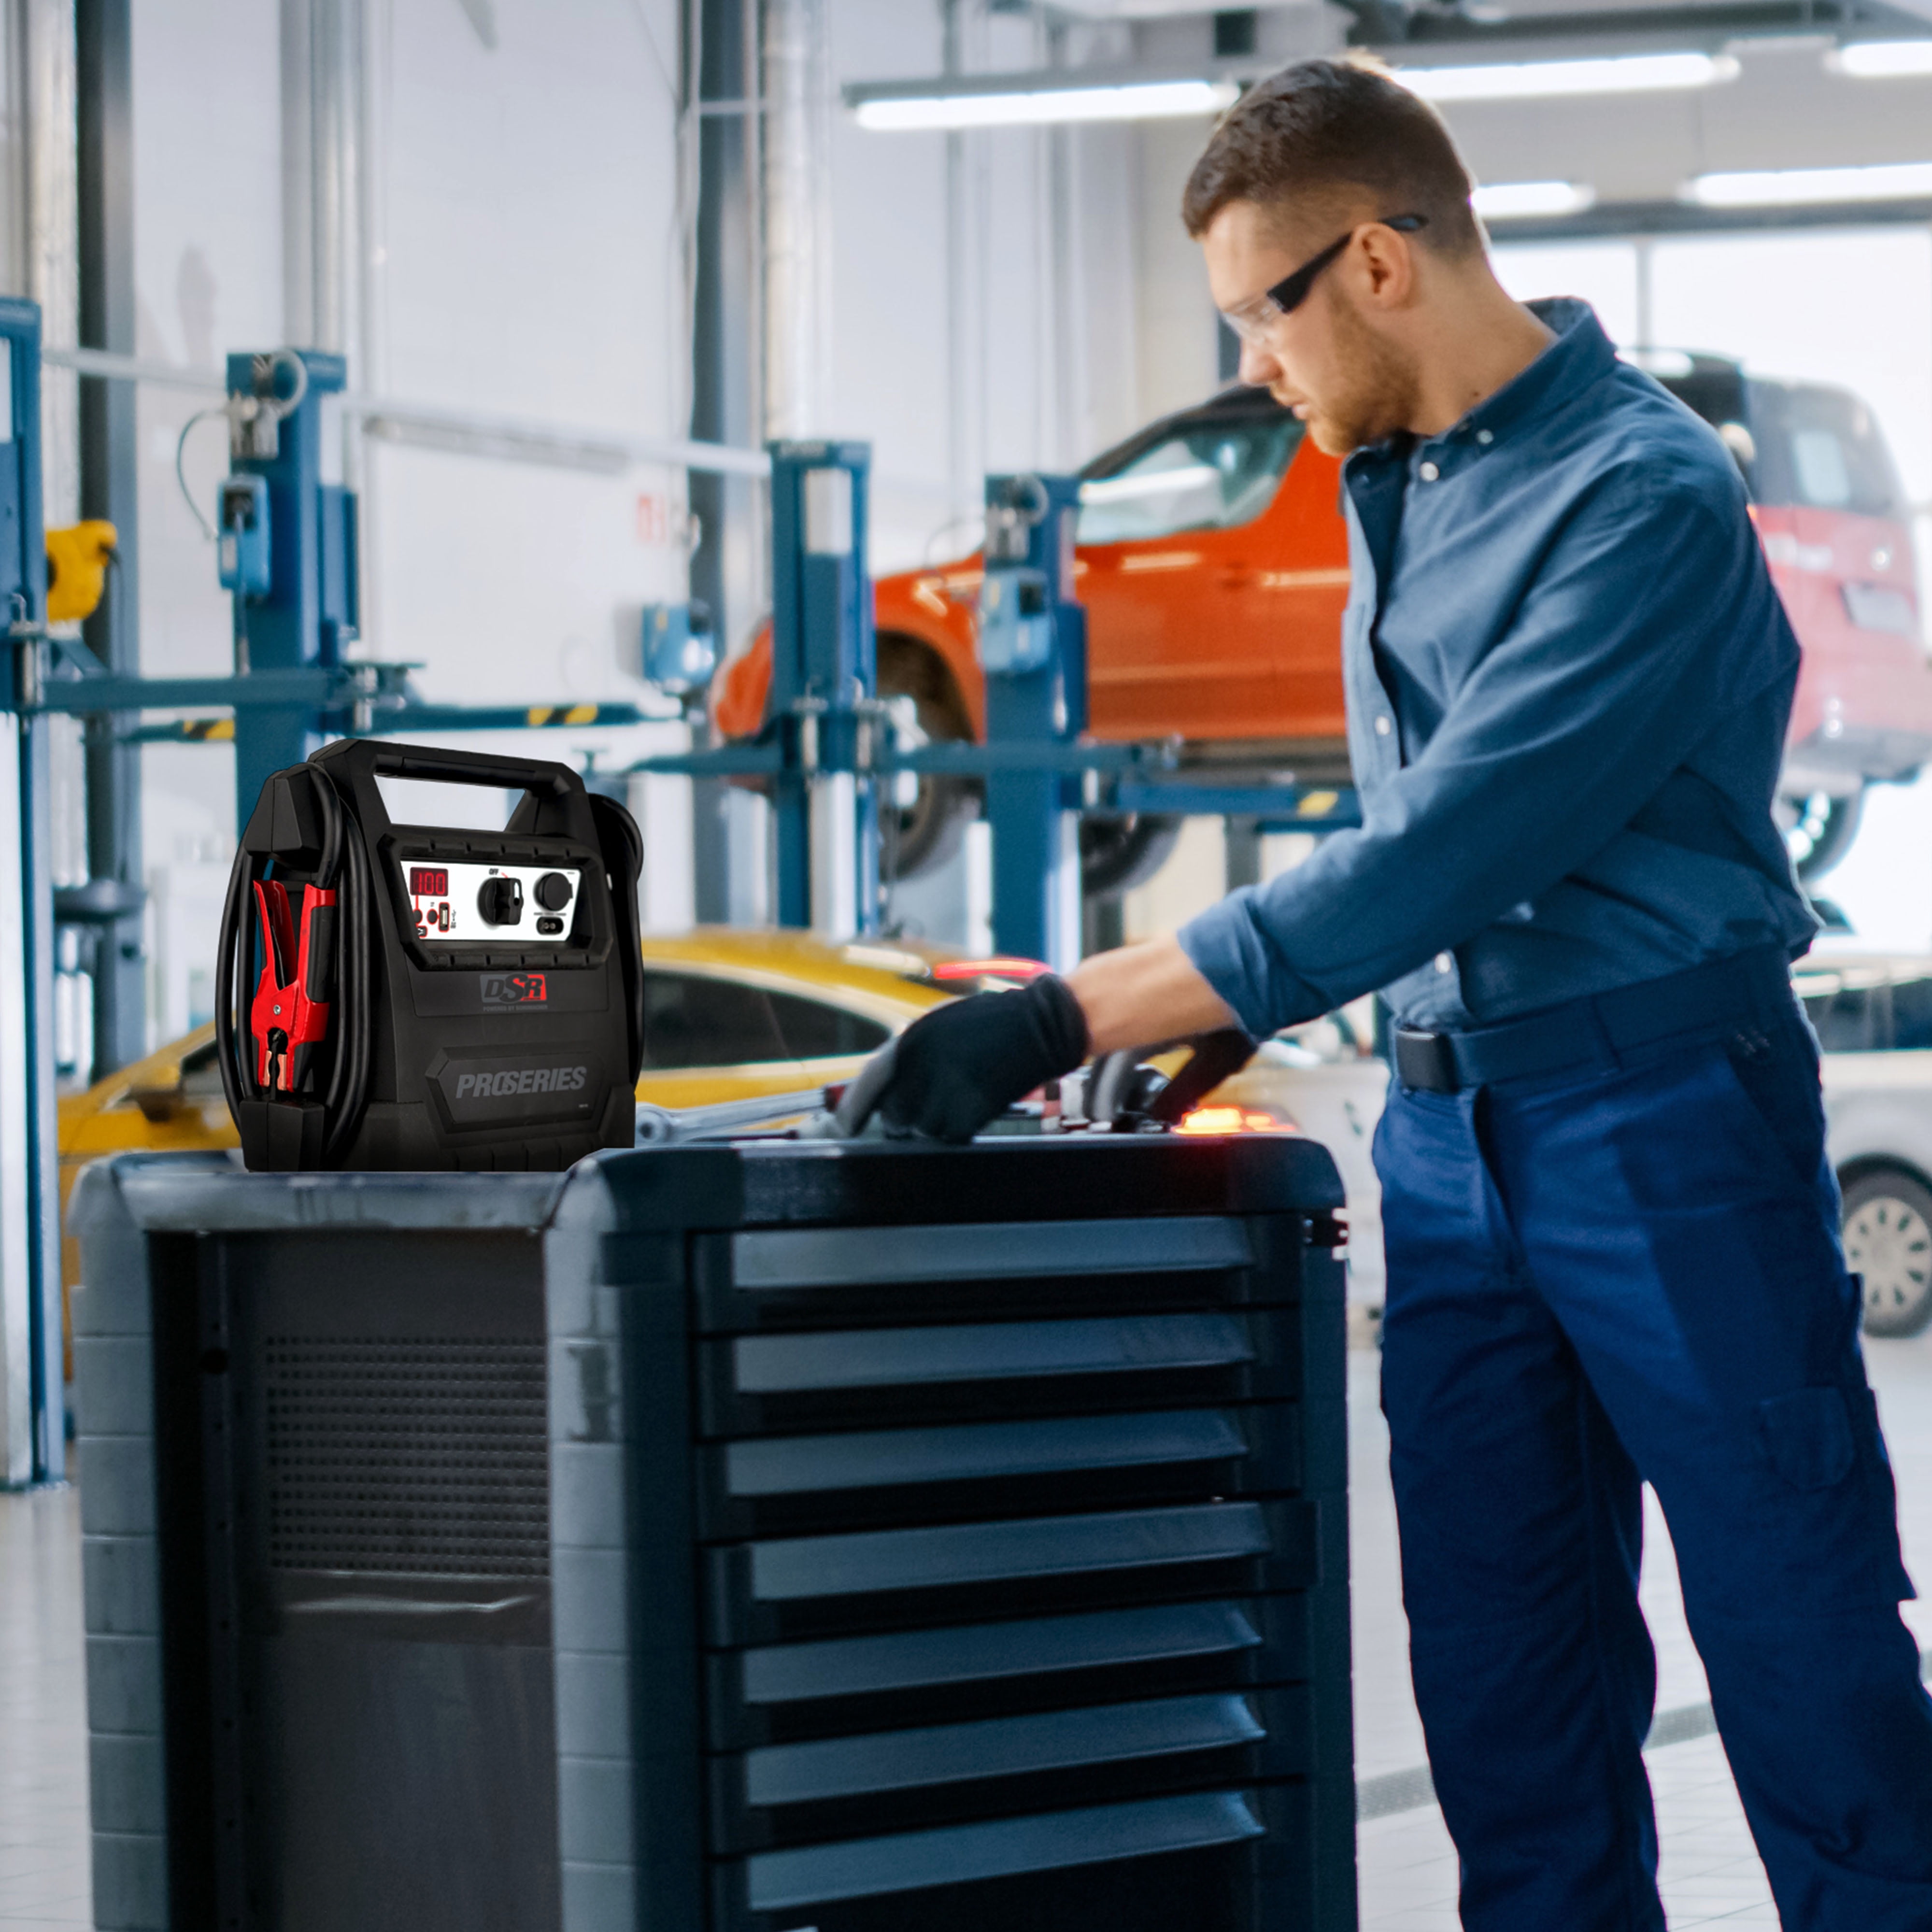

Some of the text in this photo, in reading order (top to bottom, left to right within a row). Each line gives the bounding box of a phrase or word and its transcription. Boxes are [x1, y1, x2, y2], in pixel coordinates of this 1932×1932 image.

[418, 872, 445, 895] 100
[484, 972, 543, 1002] DSR
[455, 1066, 587, 1099] PROSERIES
